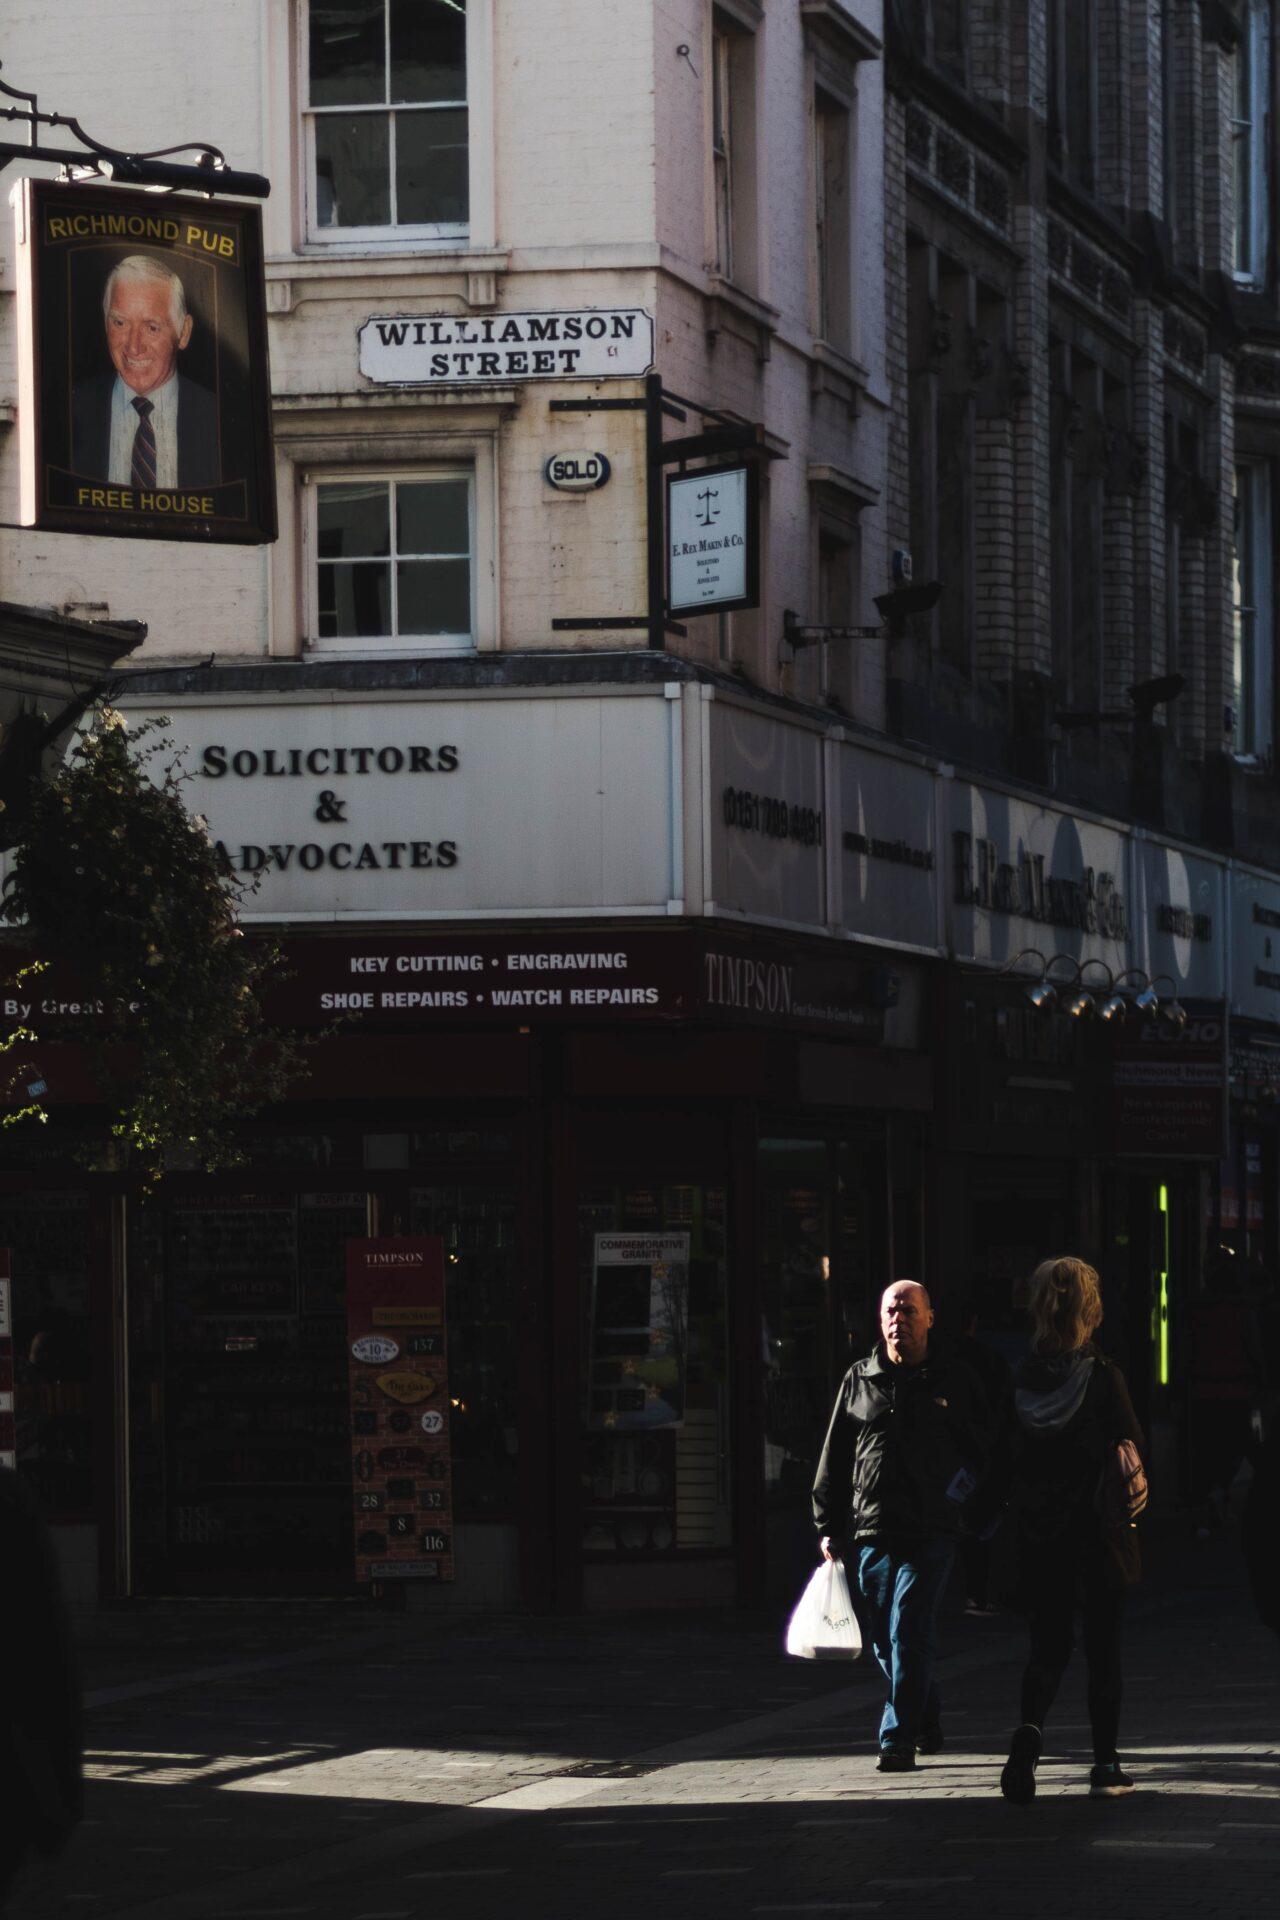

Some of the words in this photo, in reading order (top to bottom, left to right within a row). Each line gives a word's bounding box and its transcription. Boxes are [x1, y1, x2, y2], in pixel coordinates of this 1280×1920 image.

[49, 214, 180, 241] RICHMOND
[186, 225, 236, 257] PUB
[376, 315, 636, 346] WILLIAMSON
[430, 349, 581, 376] STREET
[553, 459, 598, 480] SOLO
[78, 487, 134, 511] FREE
[141, 491, 216, 515] HOUSE
[724, 536, 730, 548] &
[202, 745, 458, 778] SOLICITORS
[314, 790, 347, 823] &
[350, 956, 389, 974] KEY
[395, 954, 484, 973] CUTTING
[507, 952, 628, 971] ENGRAVING
[705, 952, 793, 1014] TIMPSON
[320, 991, 375, 1009] SHOE
[381, 989, 469, 1008] REPAIRS
[490, 988, 563, 1006] WATCH
[569, 987, 660, 1005] REPAIRS
[4, 999, 32, 1020] By
[600, 1240, 685, 1249] COMMEMORATIVE
[365, 1252, 424, 1264] TIMPSON
[414, 1338, 434, 1353] 137
[425, 1416, 439, 1428] 27
[361, 1494, 378, 1508] 28
[397, 1517, 407, 1532] 8
[425, 1535, 444, 1550] 116
